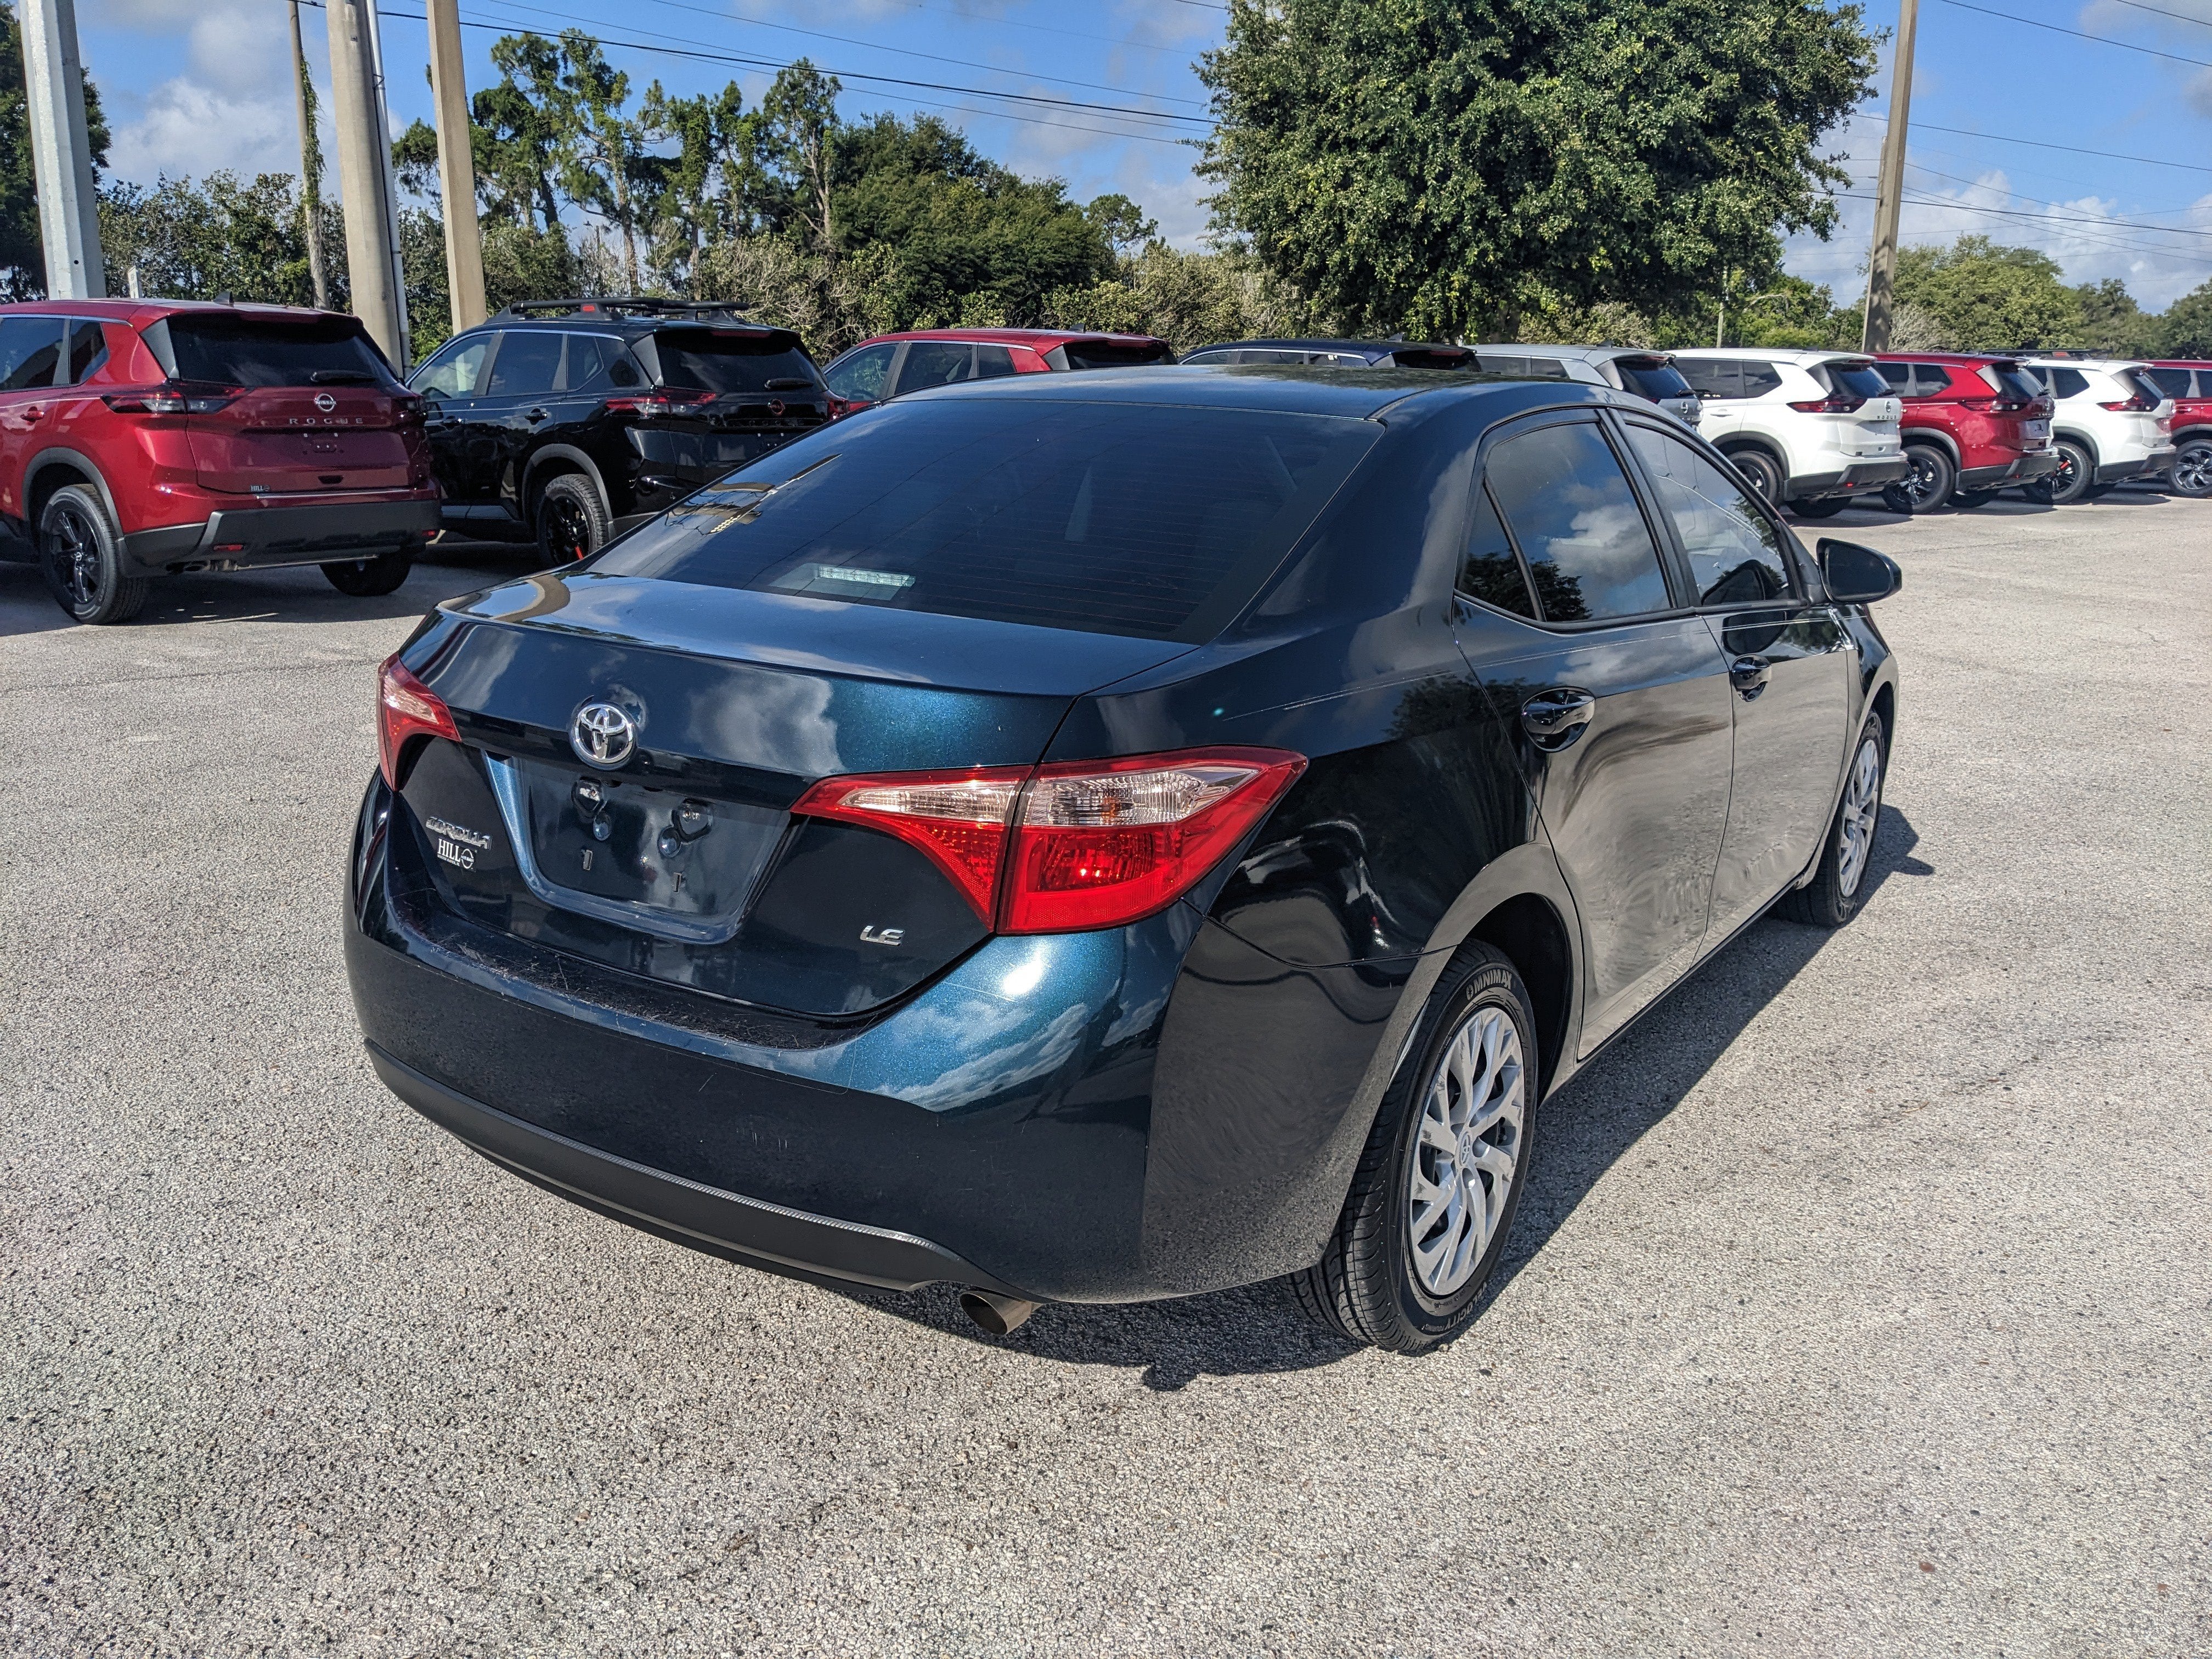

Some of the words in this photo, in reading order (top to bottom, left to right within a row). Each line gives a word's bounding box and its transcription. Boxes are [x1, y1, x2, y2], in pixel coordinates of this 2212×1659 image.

[426, 816, 492, 850] COROLLA
[437, 838, 461, 862] HILL
[860, 925, 904, 946] LE
[1466, 969, 1512, 1000] OMNIMAX
[1444, 1282, 1487, 1330] VELOCITY
